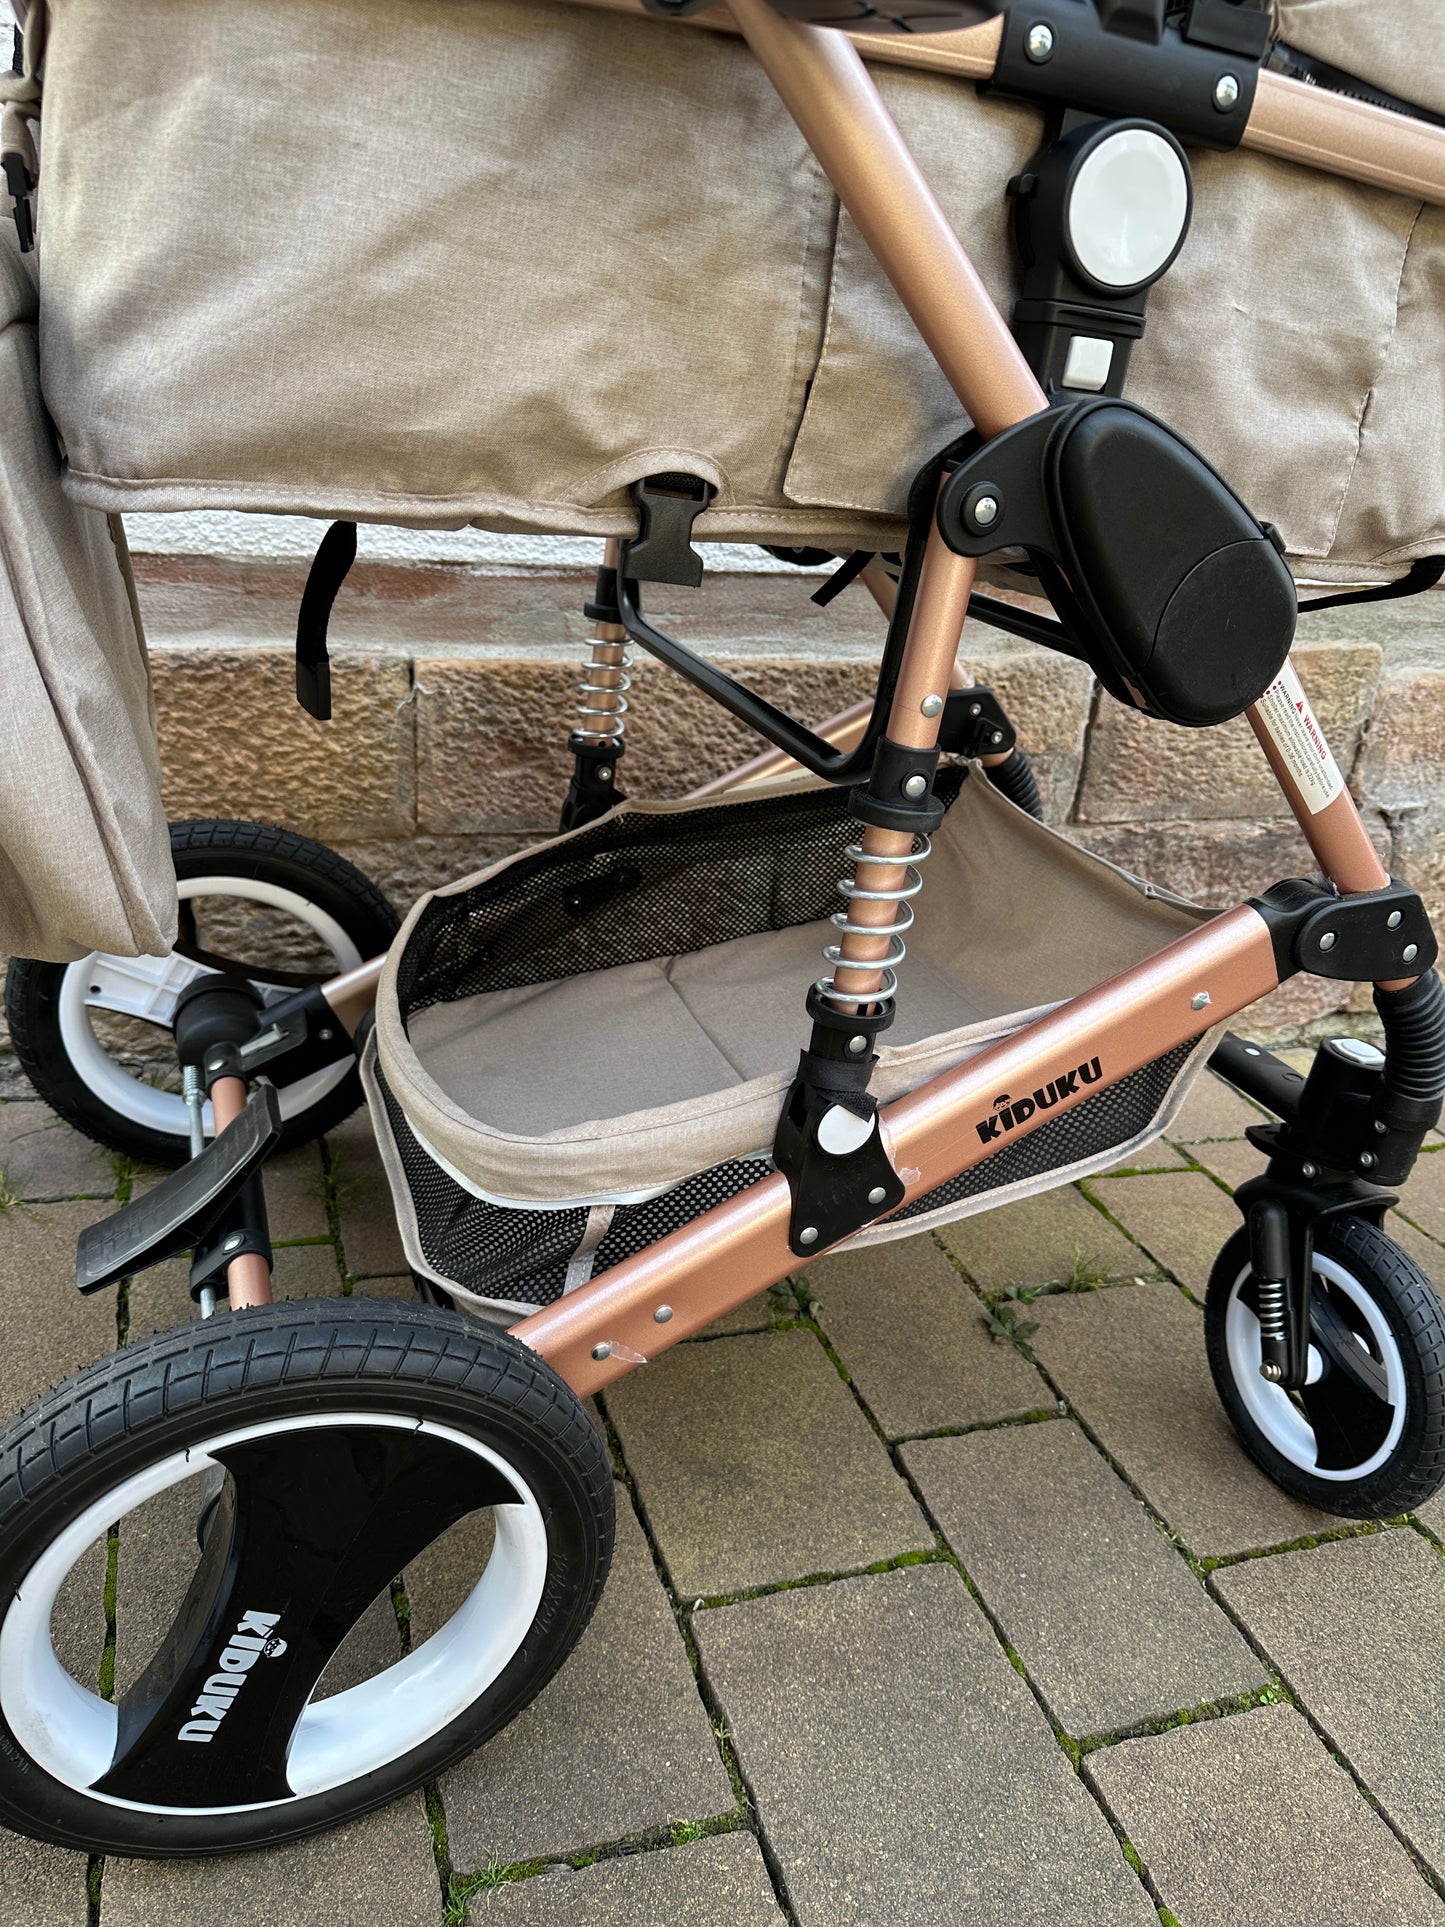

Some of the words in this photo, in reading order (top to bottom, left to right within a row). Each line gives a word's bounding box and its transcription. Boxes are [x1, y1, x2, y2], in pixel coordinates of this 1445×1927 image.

[1279, 684, 1296, 714] WARNING
[1304, 714, 1327, 760] WARNING
[976, 1056, 1103, 1144] KIDUKU
[178, 1610, 283, 1742] KIDUKU
